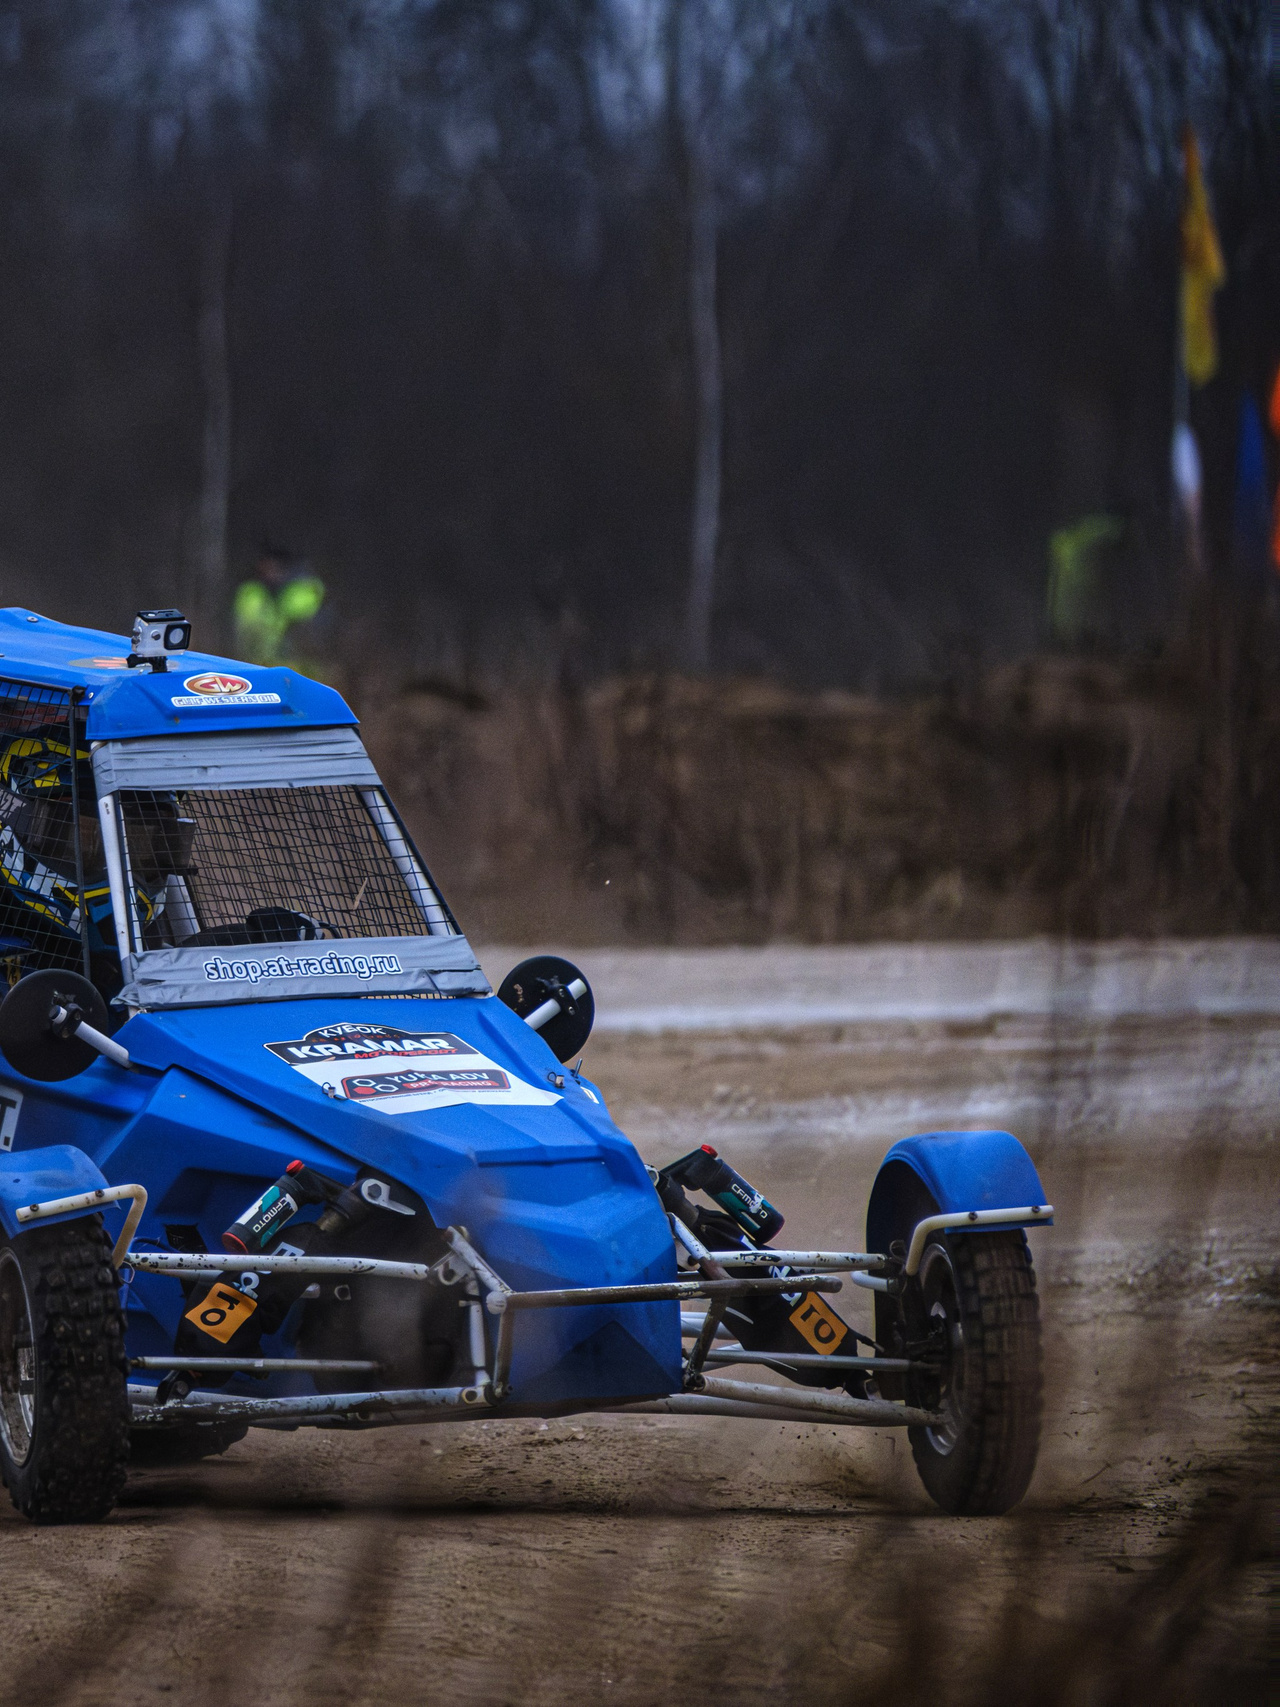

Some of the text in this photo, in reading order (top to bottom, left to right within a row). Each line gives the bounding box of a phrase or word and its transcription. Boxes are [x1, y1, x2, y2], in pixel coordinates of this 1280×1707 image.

[203, 695, 258, 704] WESTERN
[258, 694, 279, 703] OIL
[204, 952, 402, 984] shop.at-racing.ru
[287, 1038, 455, 1059] KRAMAR
[448, 1072, 491, 1081] ADV
[251, 1196, 289, 1233] CFMOTO
[731, 1183, 768, 1220] CFMO
